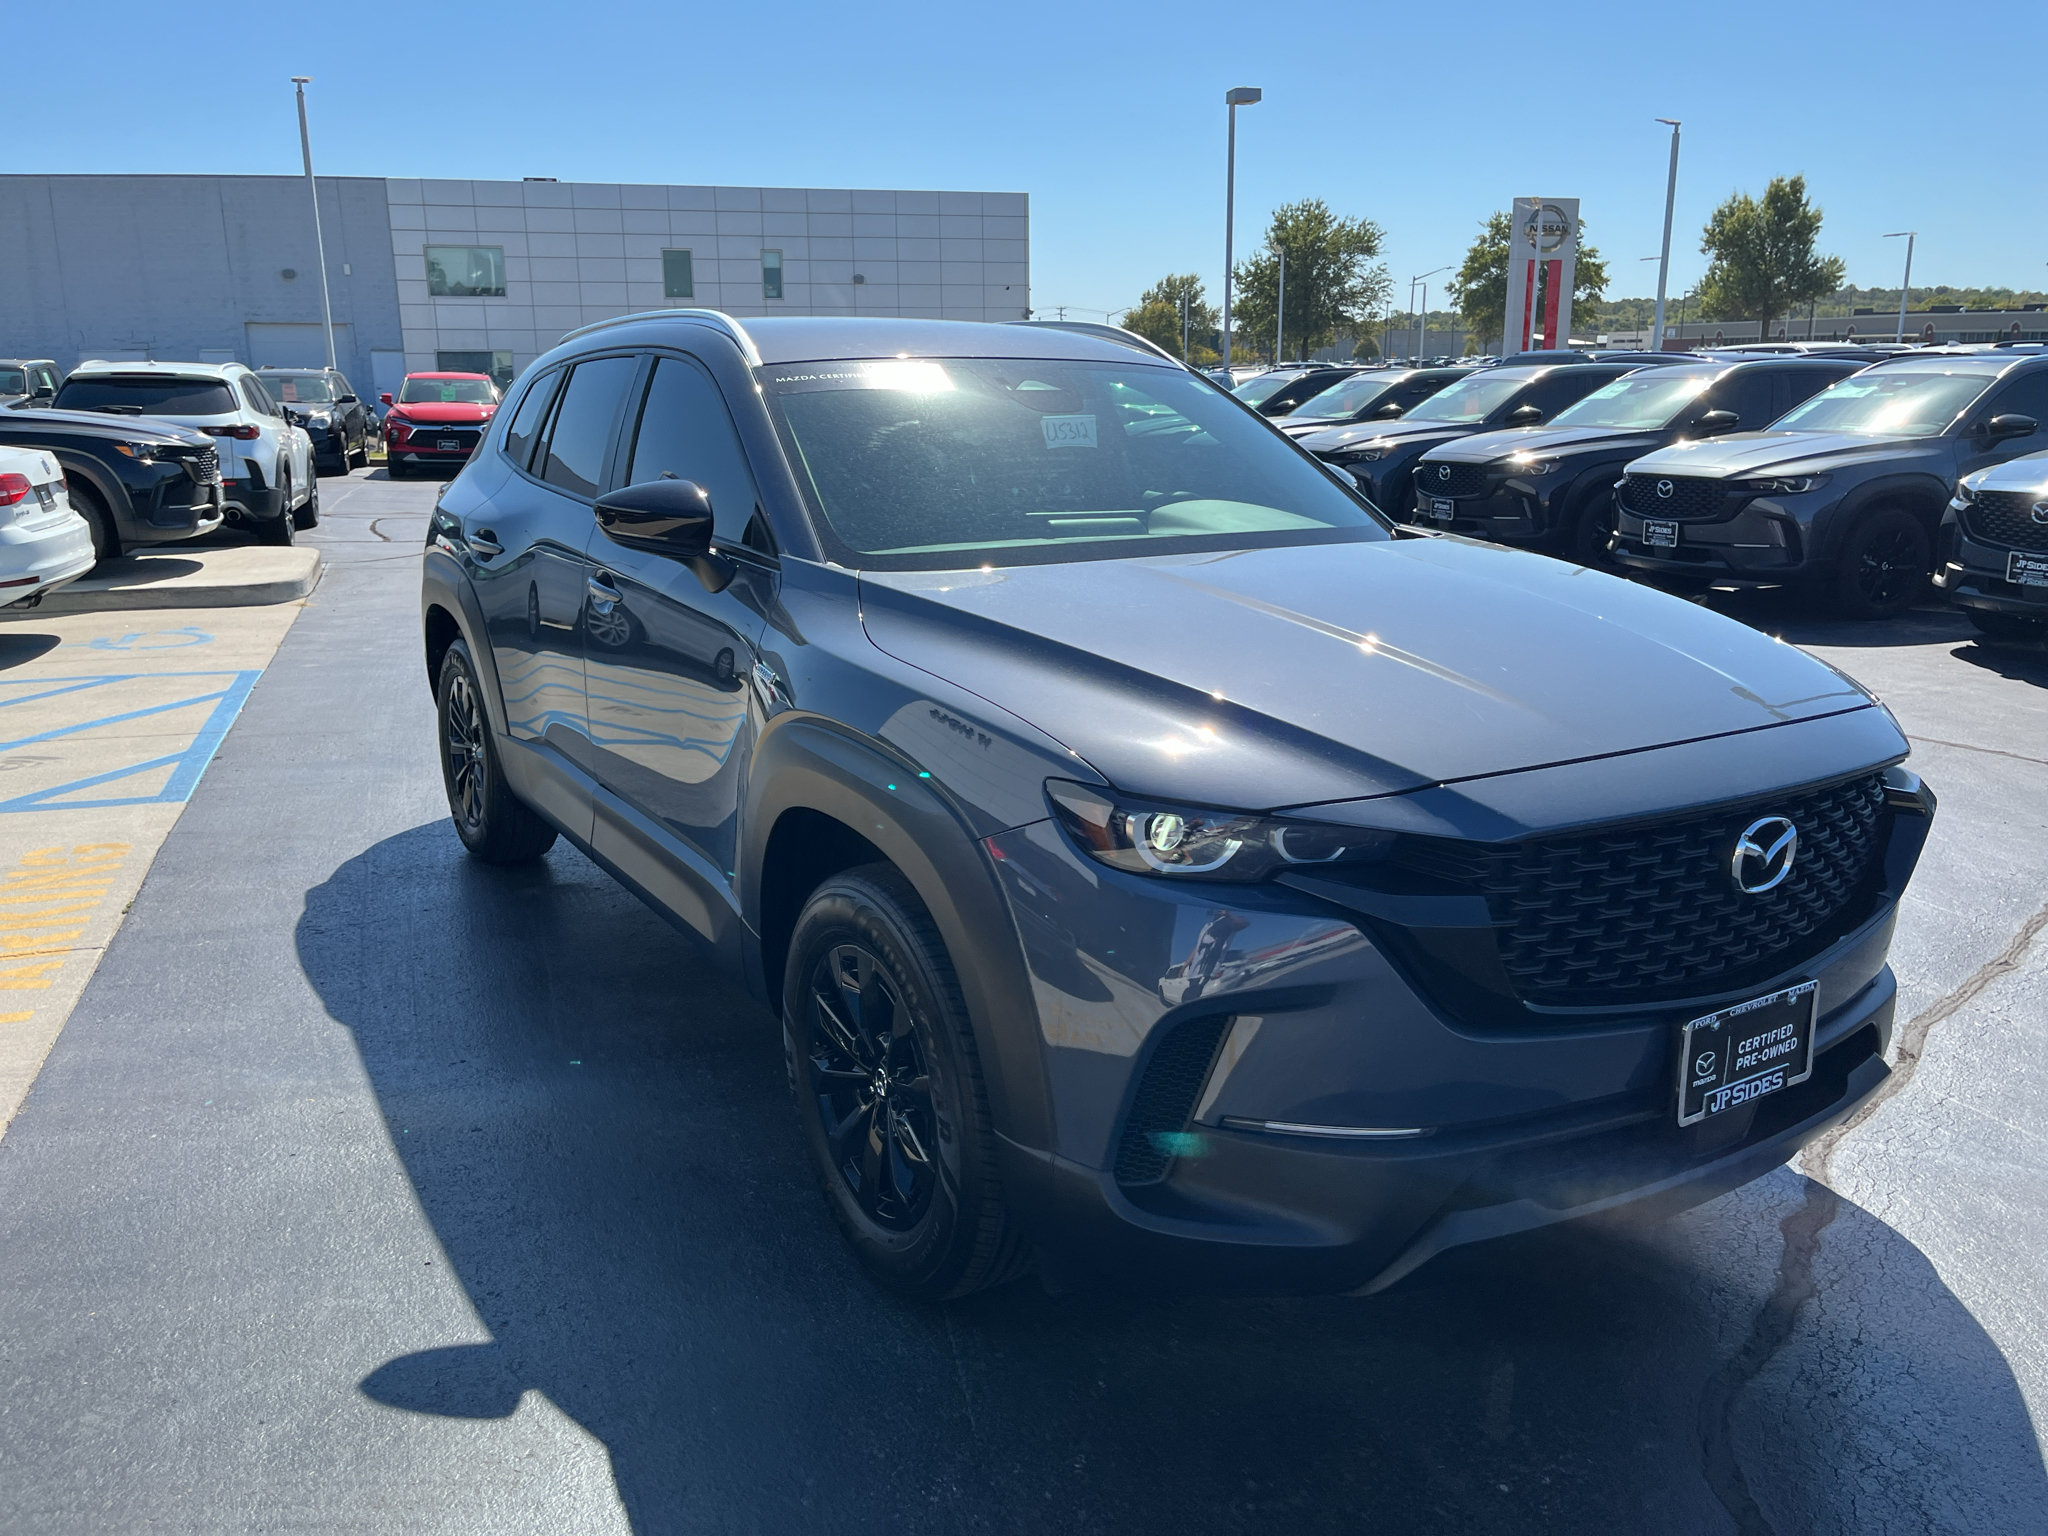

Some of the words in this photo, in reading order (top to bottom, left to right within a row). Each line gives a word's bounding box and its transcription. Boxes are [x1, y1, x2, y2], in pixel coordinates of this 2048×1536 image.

[1529, 224, 1569, 233] NSSAN
[775, 374, 817, 383] MAZDA
[1694, 1015, 1718, 1029] FORD
[1729, 994, 1779, 1017] CHEVROLET
[1787, 983, 1816, 997] MAZDA
[1738, 1023, 1794, 1054] CERTIFIED
[1735, 1037, 1798, 1071] PRE-OWNED
[1692, 1074, 1717, 1088] mazda
